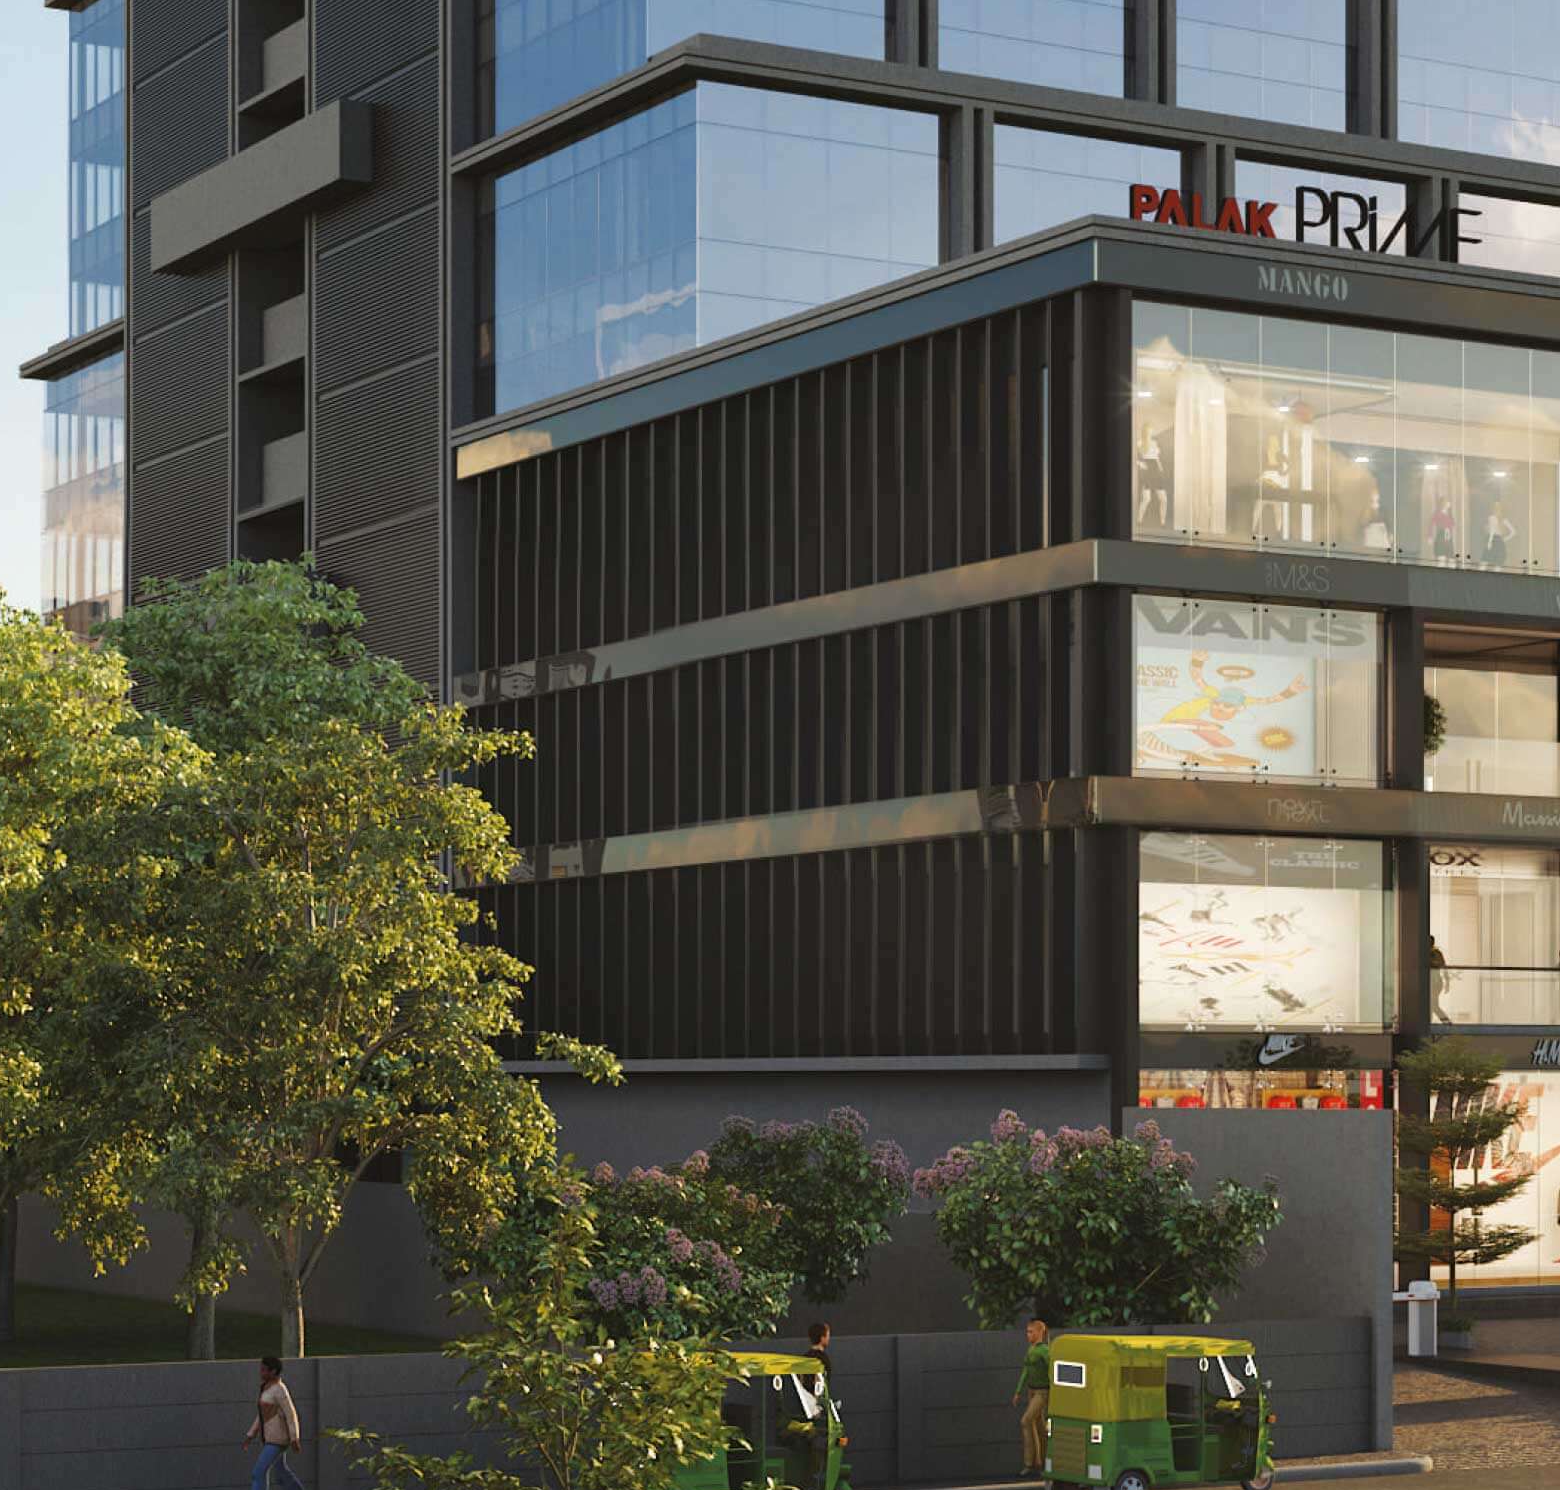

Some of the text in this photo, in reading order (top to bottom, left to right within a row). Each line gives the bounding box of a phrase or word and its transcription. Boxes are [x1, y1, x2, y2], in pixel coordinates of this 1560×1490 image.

[1129, 183, 1279, 239] PALAK
[1257, 265, 1349, 302] MANGO
[1135, 595, 1369, 647] VANS
